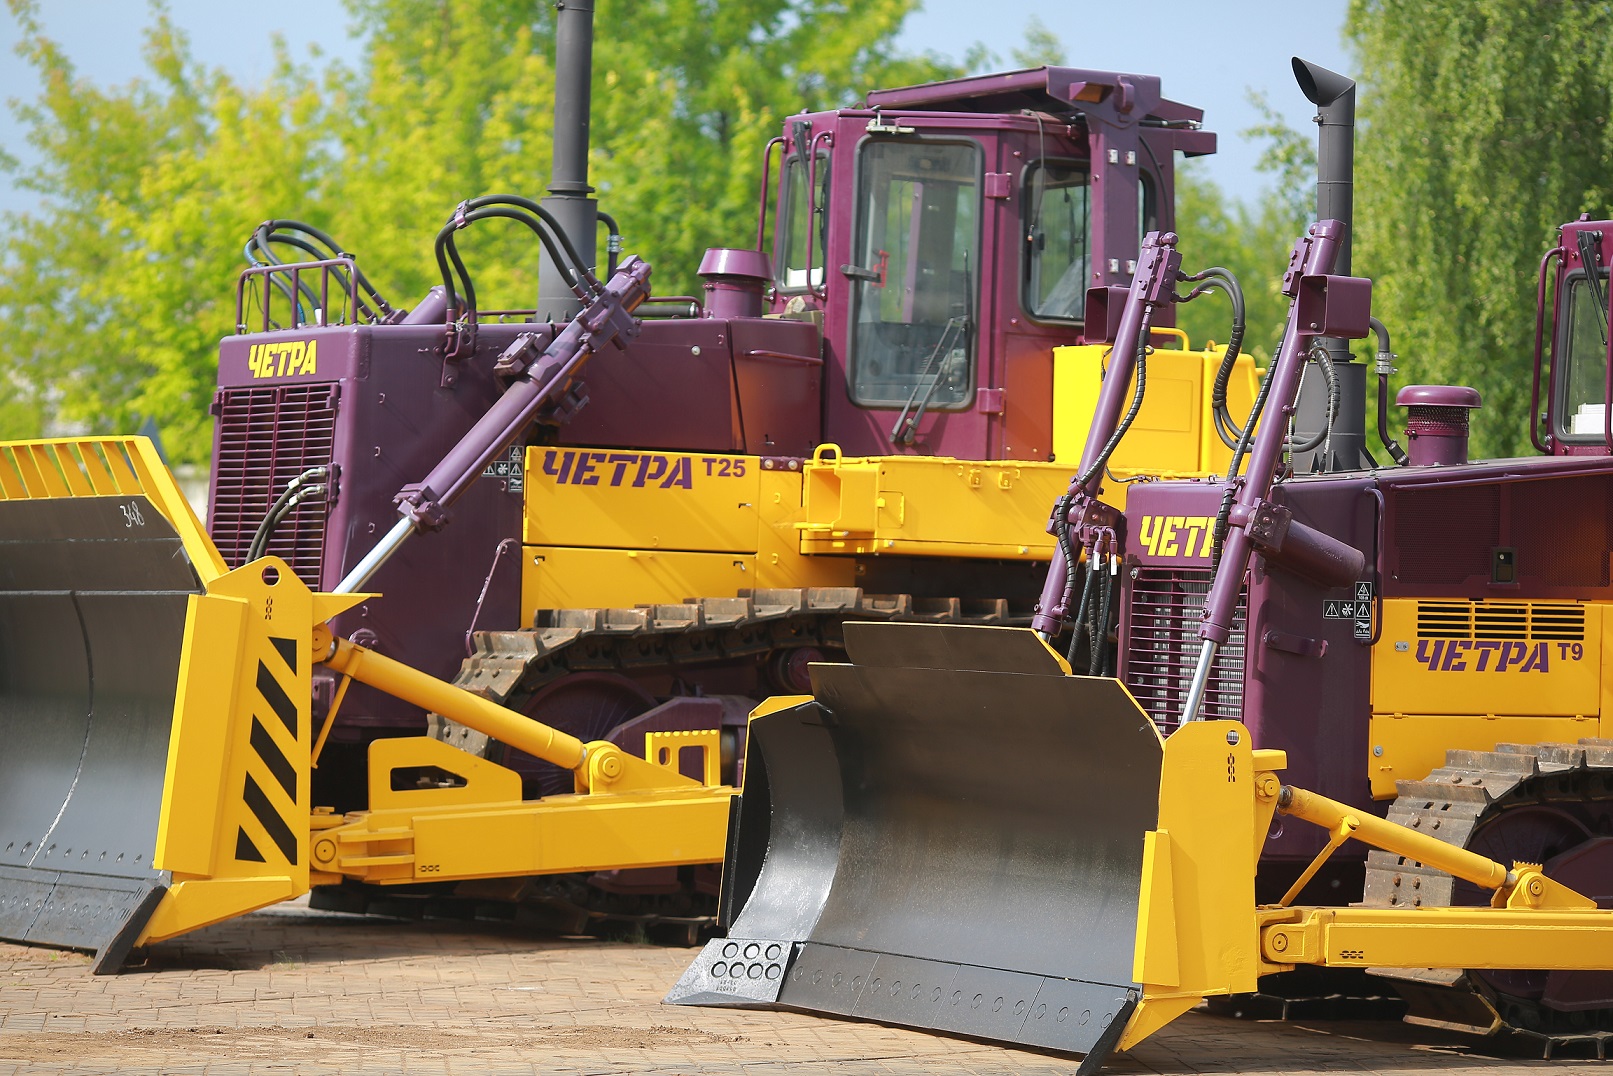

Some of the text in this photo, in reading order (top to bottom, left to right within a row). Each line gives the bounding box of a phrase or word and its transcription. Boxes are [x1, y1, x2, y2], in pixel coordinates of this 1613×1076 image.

[248, 339, 317, 378] ЧЕТРА
[542, 451, 693, 489] ЧЕТРА
[120, 501, 144, 527] 348
[1415, 639, 1549, 673] ЧЕТРА
